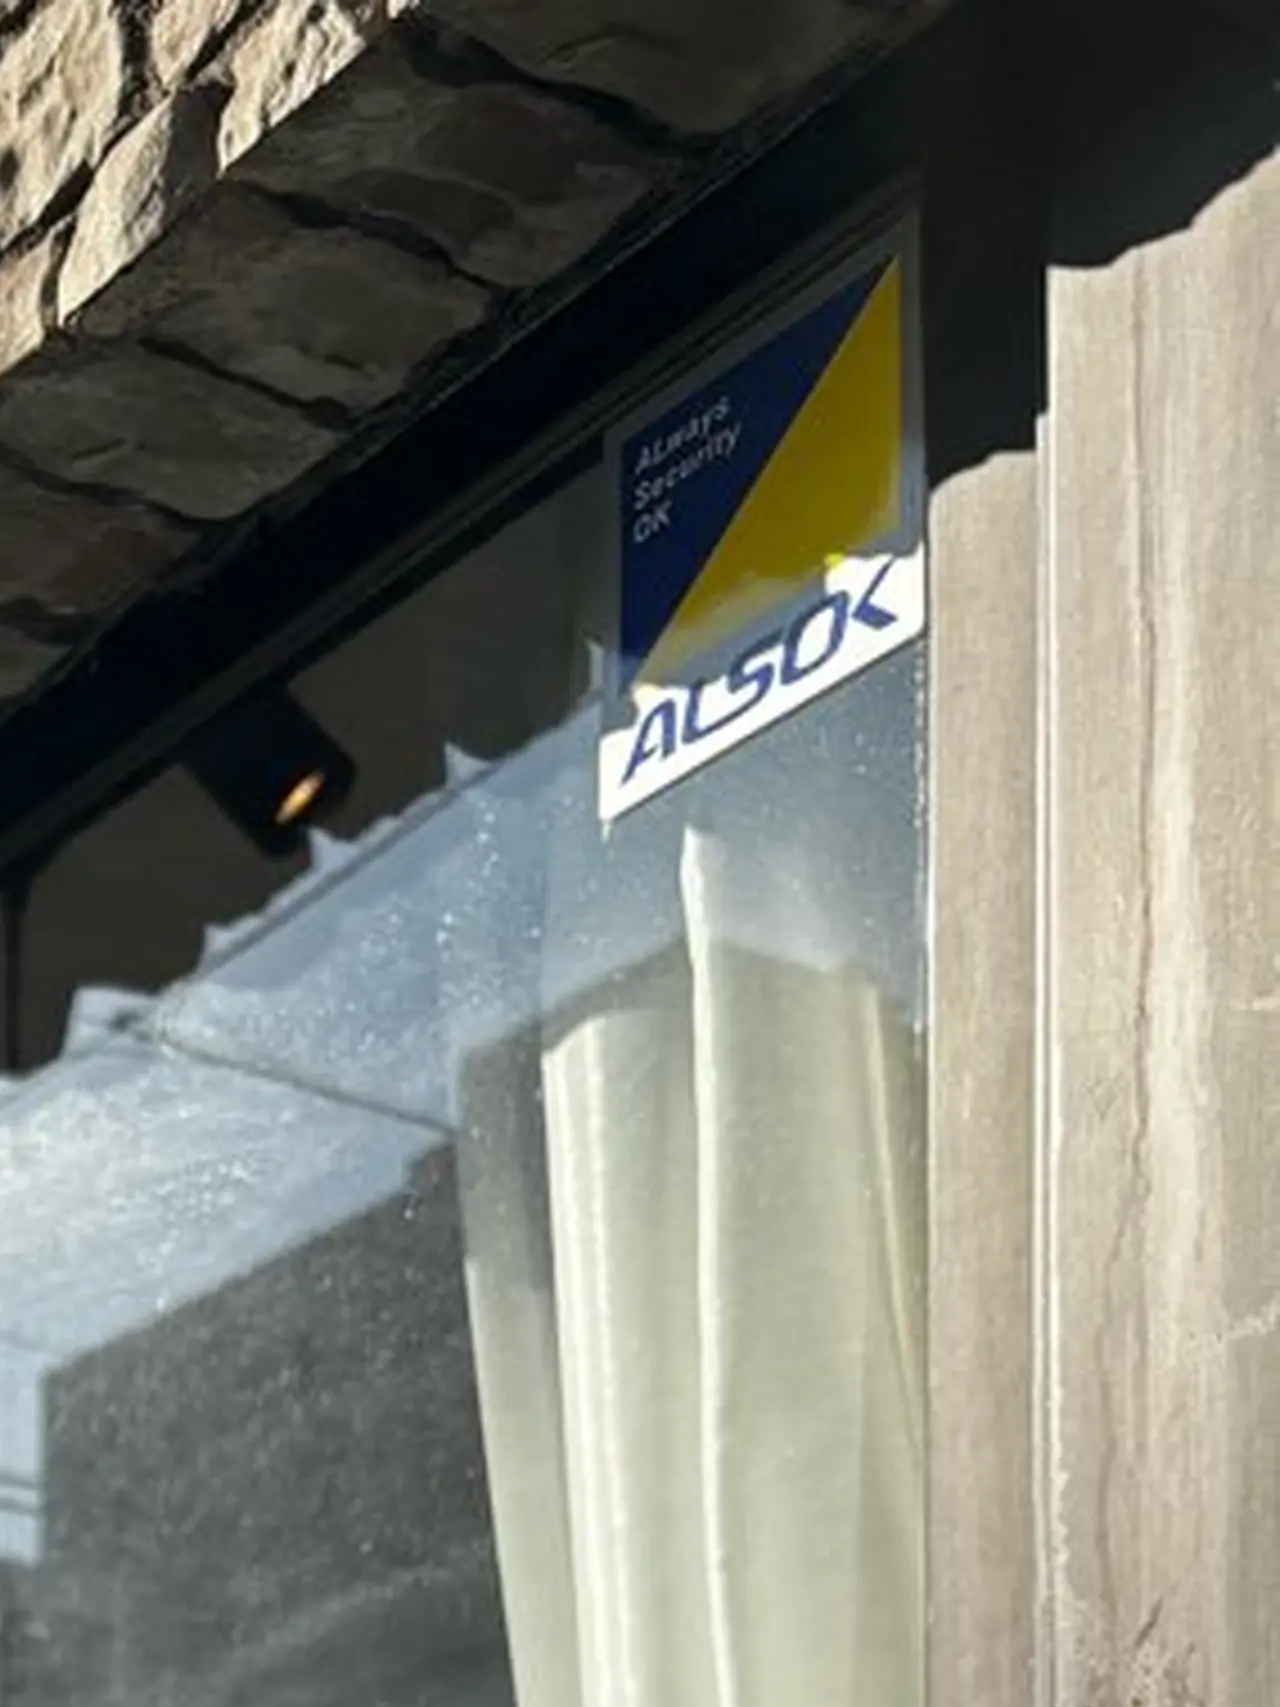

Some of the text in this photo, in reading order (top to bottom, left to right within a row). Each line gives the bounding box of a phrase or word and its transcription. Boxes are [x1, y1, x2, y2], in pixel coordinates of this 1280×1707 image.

[633, 421, 742, 510] Security
[633, 499, 673, 544] OK
[621, 554, 899, 785] ALSOK
